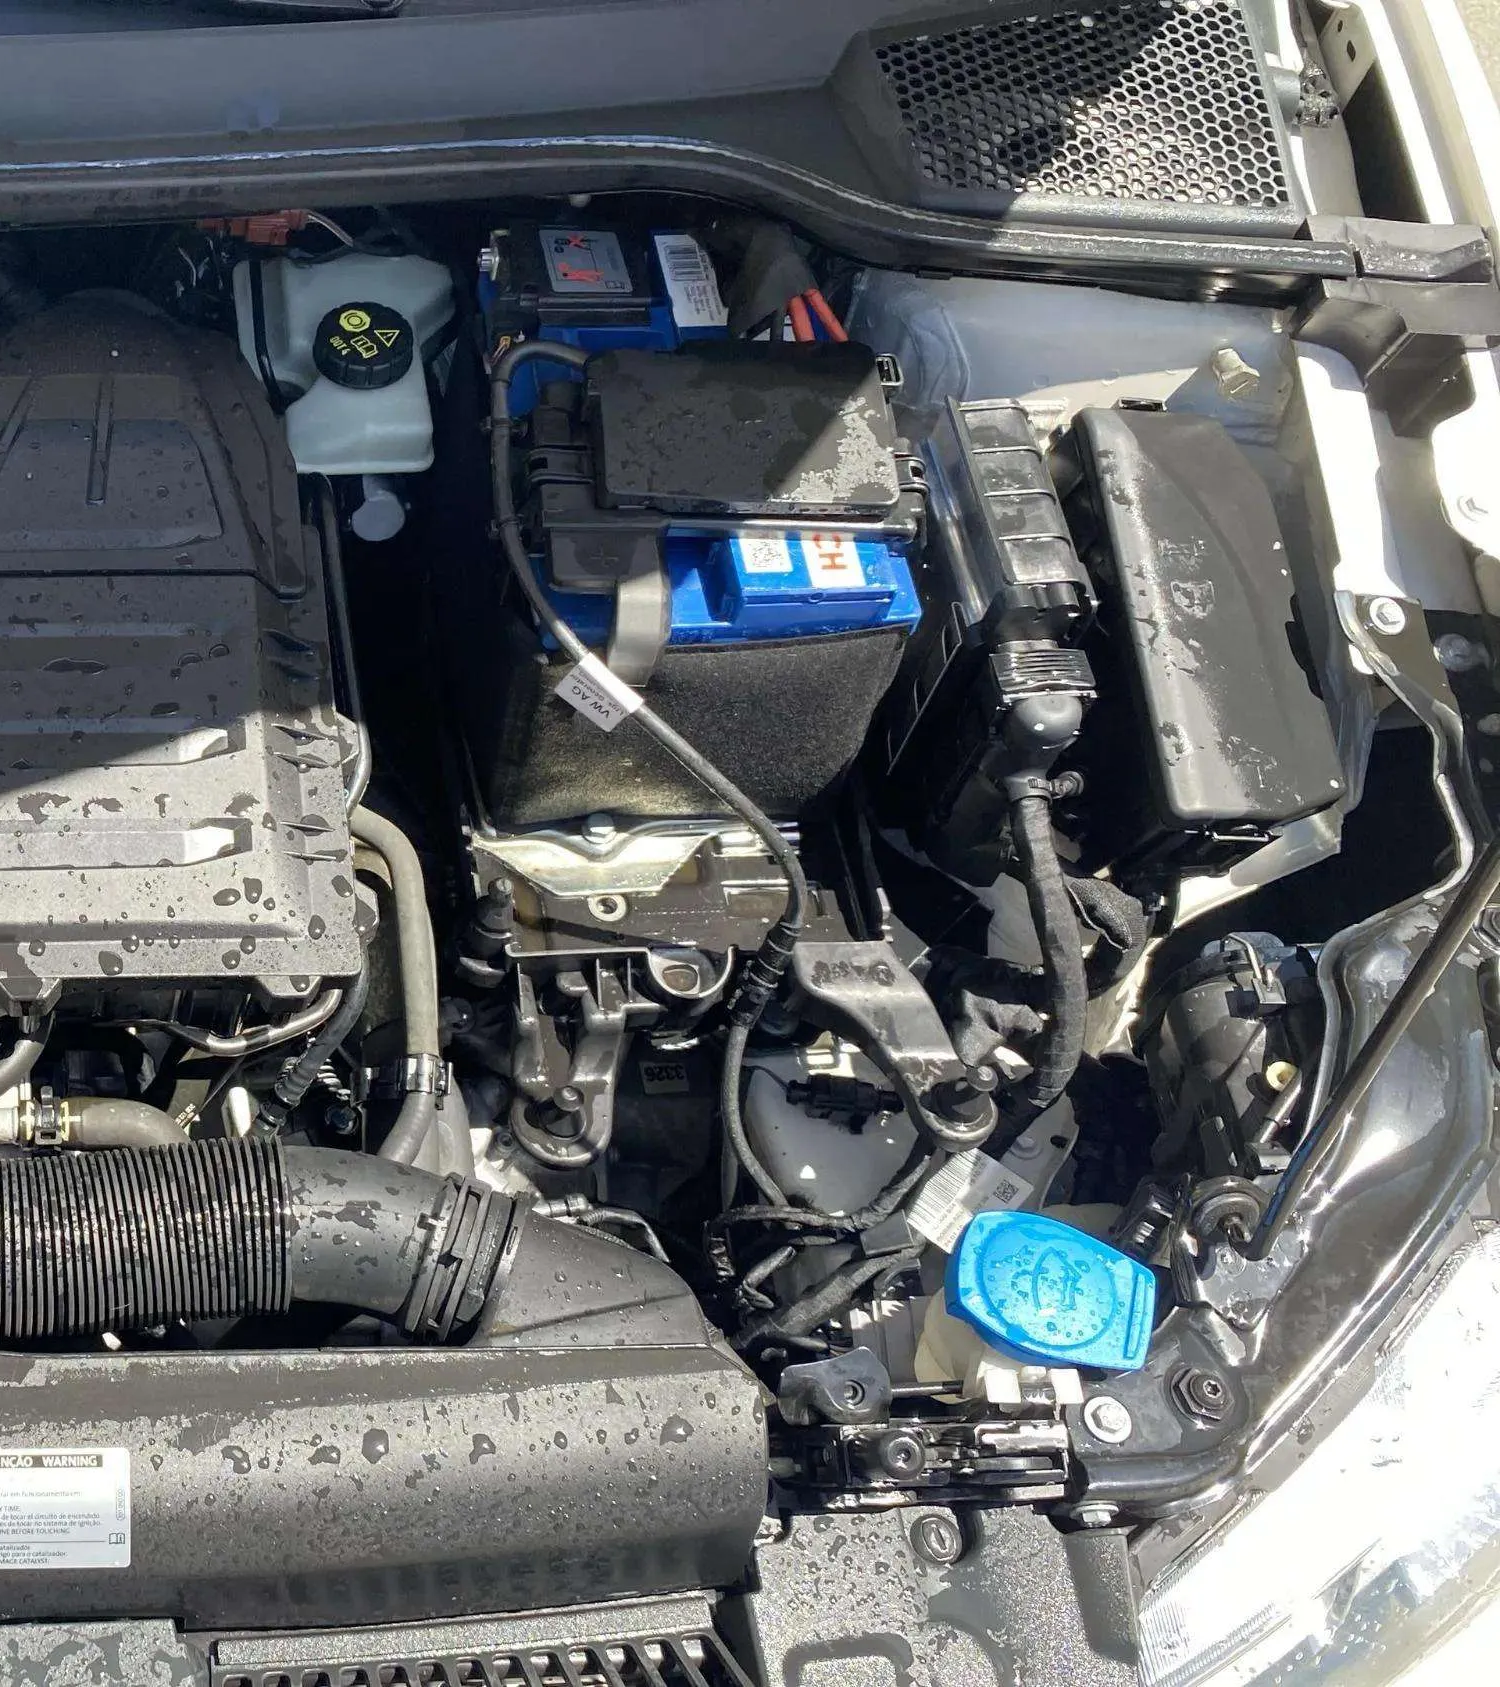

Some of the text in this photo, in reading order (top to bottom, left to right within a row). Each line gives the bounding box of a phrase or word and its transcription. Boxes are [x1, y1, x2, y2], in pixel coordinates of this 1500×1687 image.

[572, 686, 609, 718] VW AG
[42, 1455, 97, 1467] WARNING
